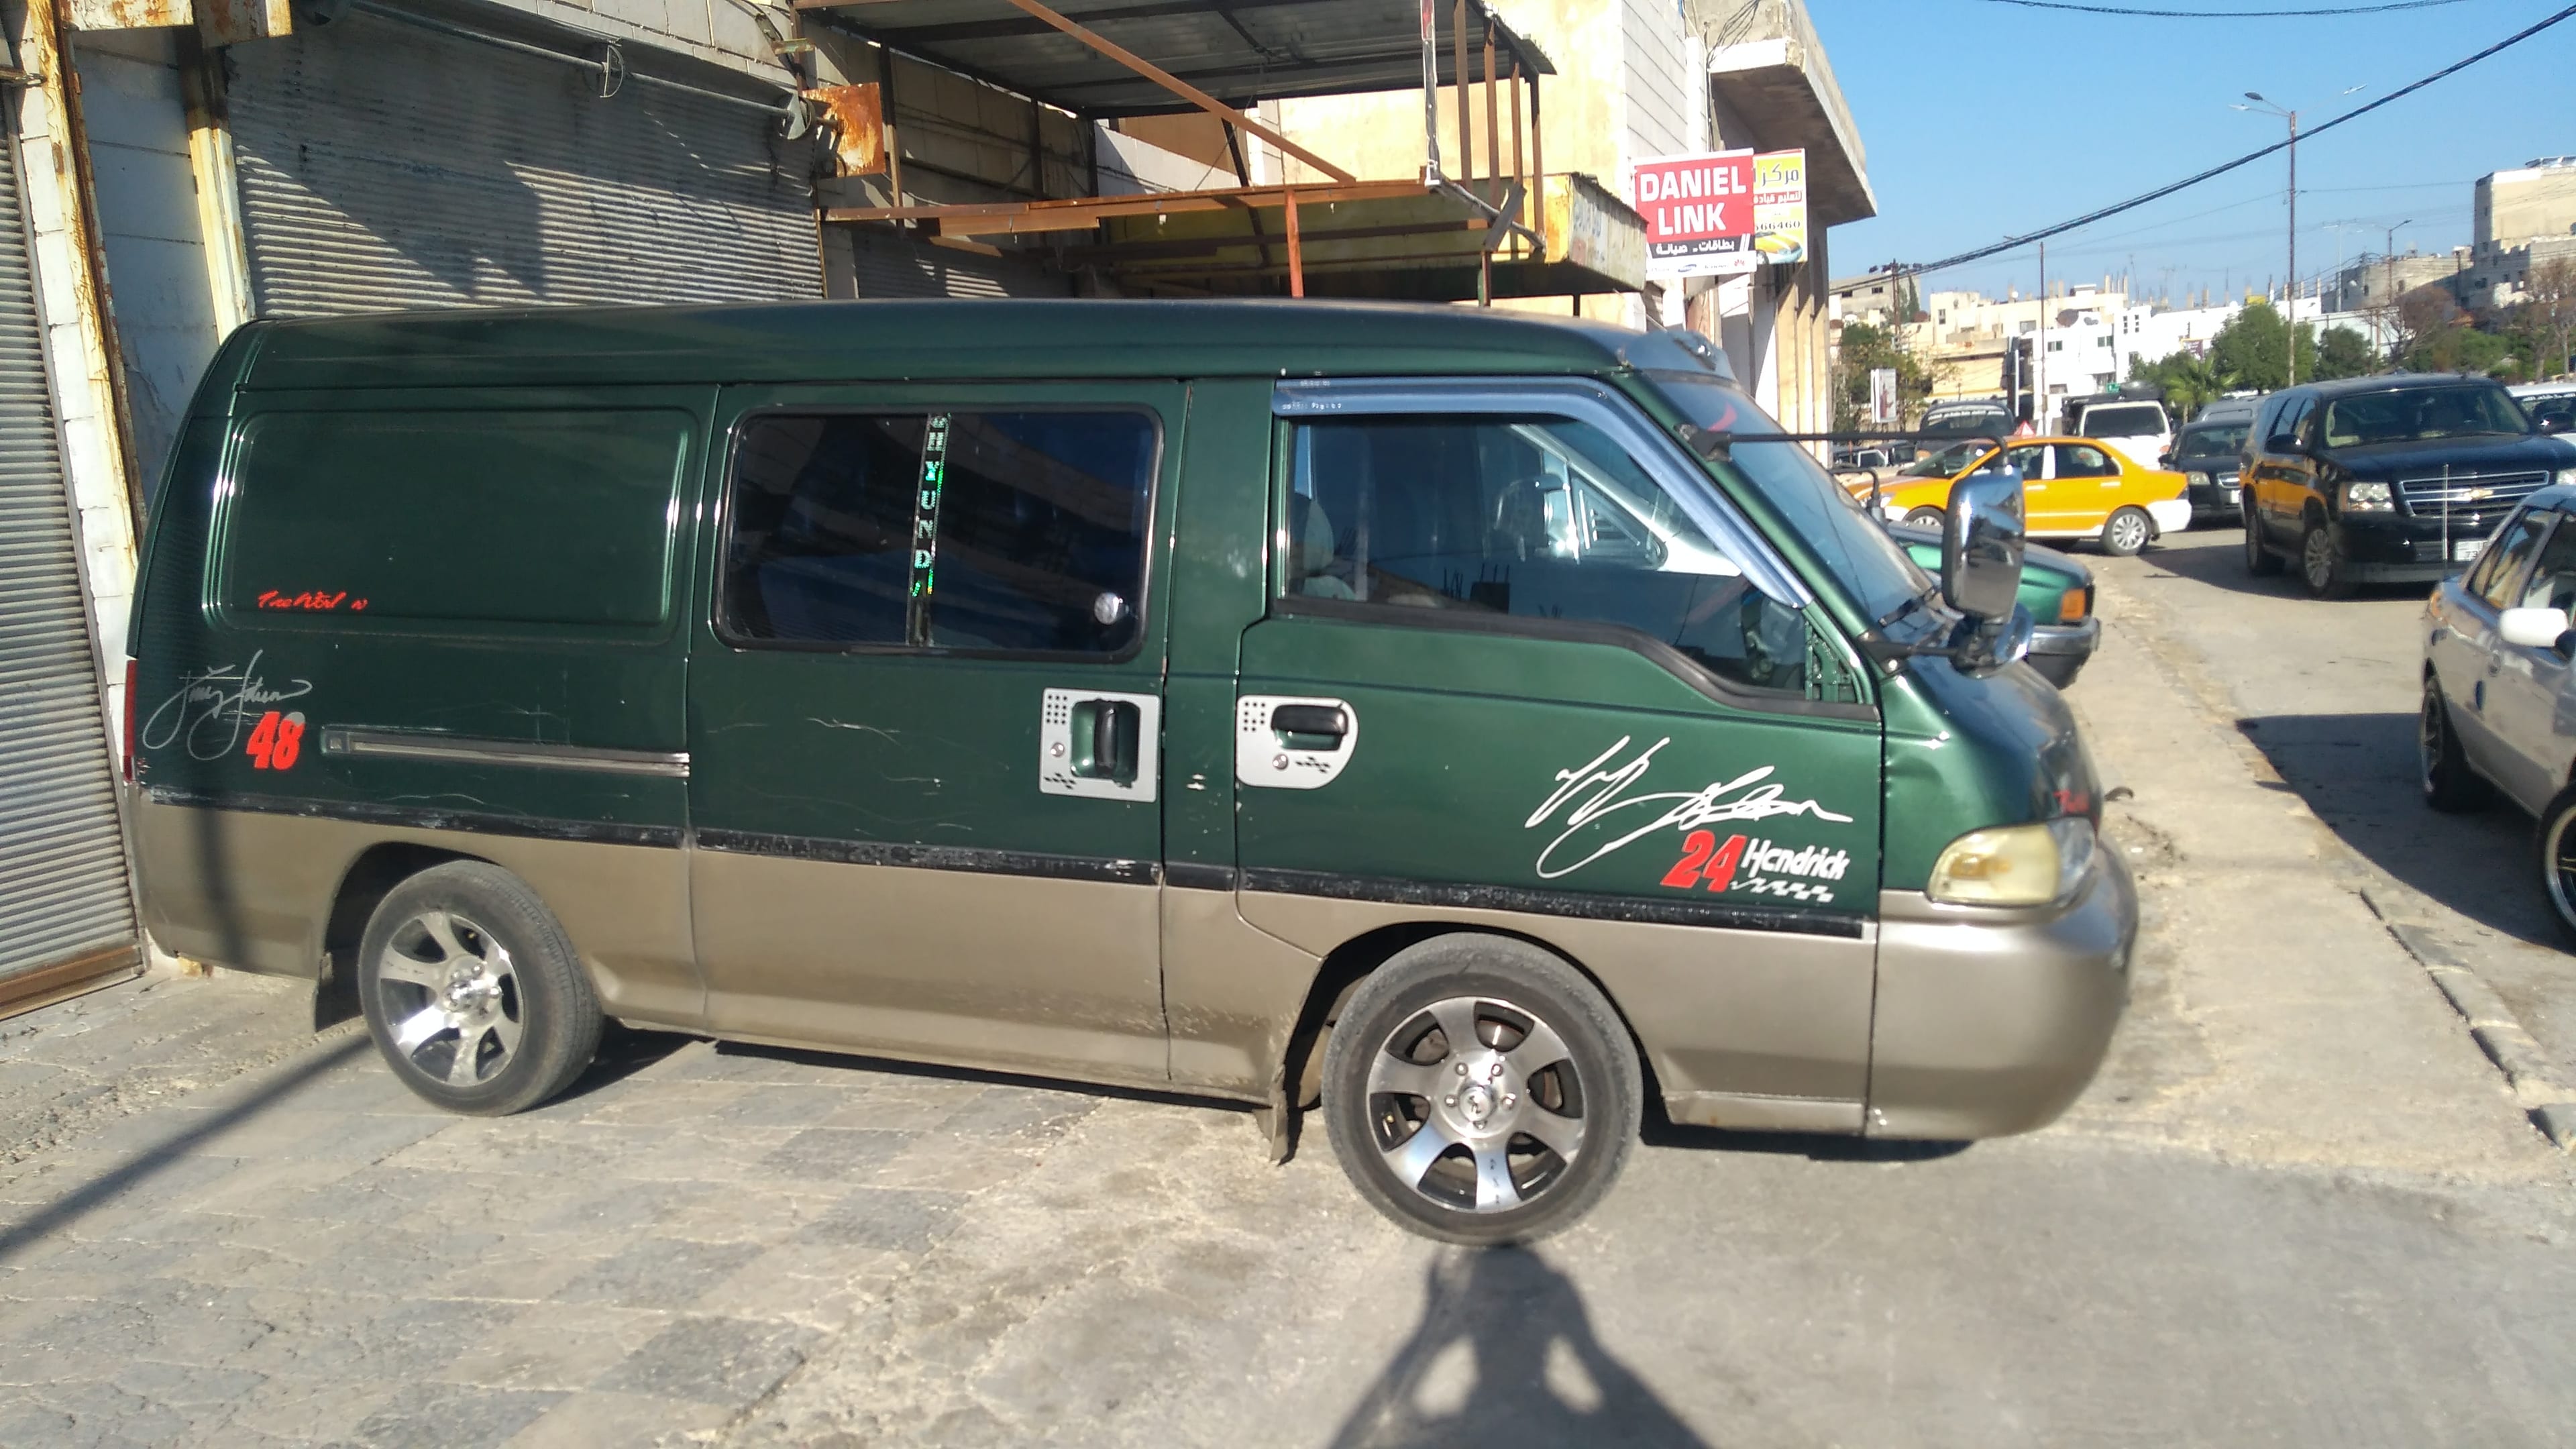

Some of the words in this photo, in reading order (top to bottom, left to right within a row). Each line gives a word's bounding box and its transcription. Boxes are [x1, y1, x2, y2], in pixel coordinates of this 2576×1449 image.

[1640, 166, 1747, 203] DANIEL
[1762, 164, 1799, 186] مركز
[1658, 203, 1727, 235] LINK
[246, 711, 306, 770] 48
[1660, 829, 1748, 893] 24
[1741, 838, 1851, 880] Hendrick
